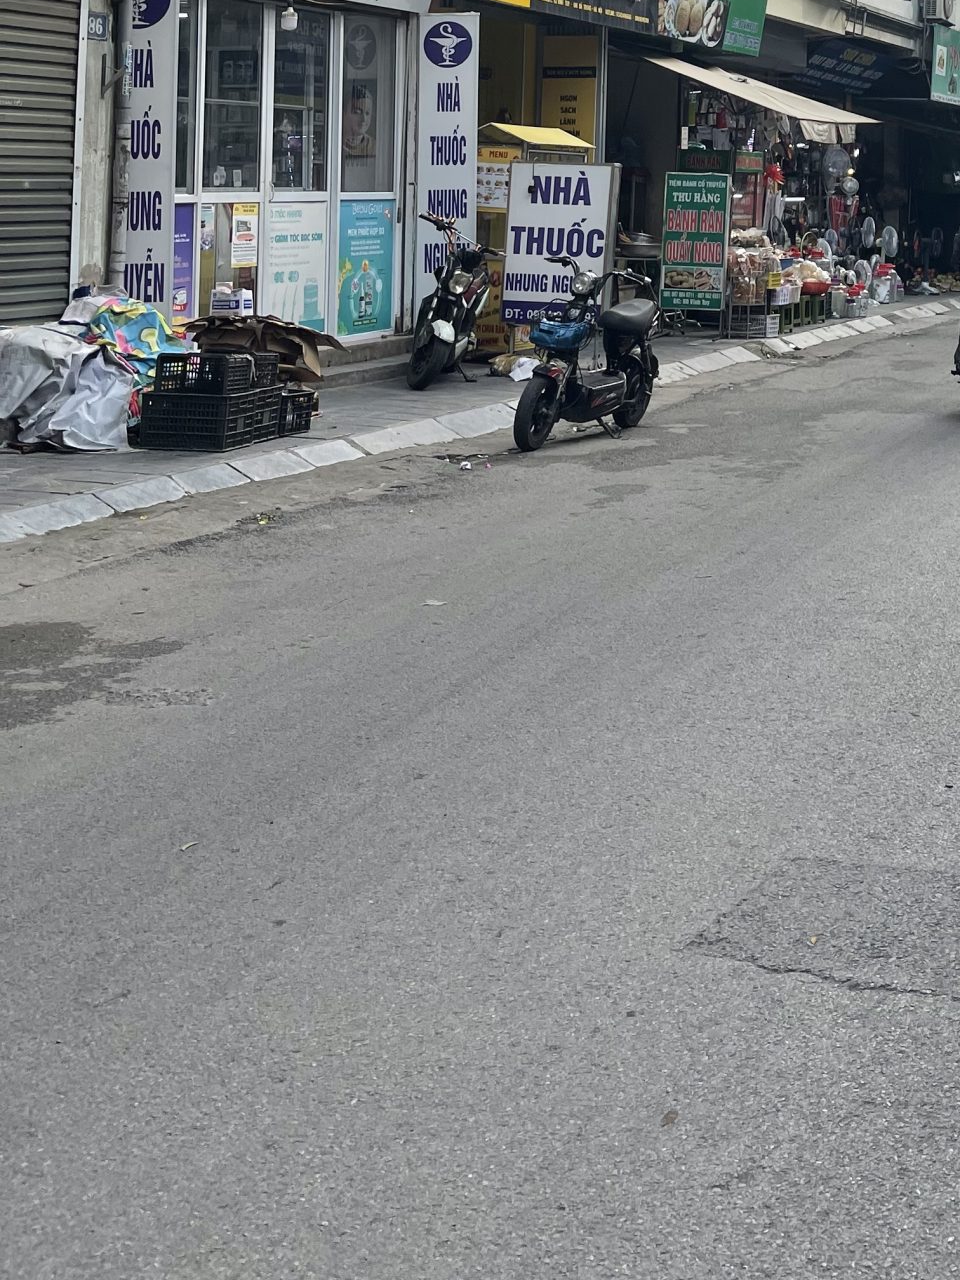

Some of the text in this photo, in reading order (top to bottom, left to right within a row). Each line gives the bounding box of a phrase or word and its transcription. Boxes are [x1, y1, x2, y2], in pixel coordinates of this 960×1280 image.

[88, 16, 103, 34] 86
[131, 40, 154, 89] HÀ
[436, 76, 461, 113] NHÀ
[131, 105, 162, 160] UỐC
[429, 124, 467, 166] THUỐC
[489, 150, 508, 159] MENU
[427, 189, 468, 219] NHUNG
[530, 170, 591, 206] NHÀ
[673, 188, 721, 203] THU HẰNG
[127, 191, 162, 231] UNG
[667, 204, 725, 234] BÁNH RÁN
[511, 218, 605, 258] THUỐC
[666, 232, 722, 265] QUẨY NÓNG
[124, 248, 165, 303] UYỄN
[505, 272, 548, 293] NHUNG
[505, 308, 524, 320] ĐT:
